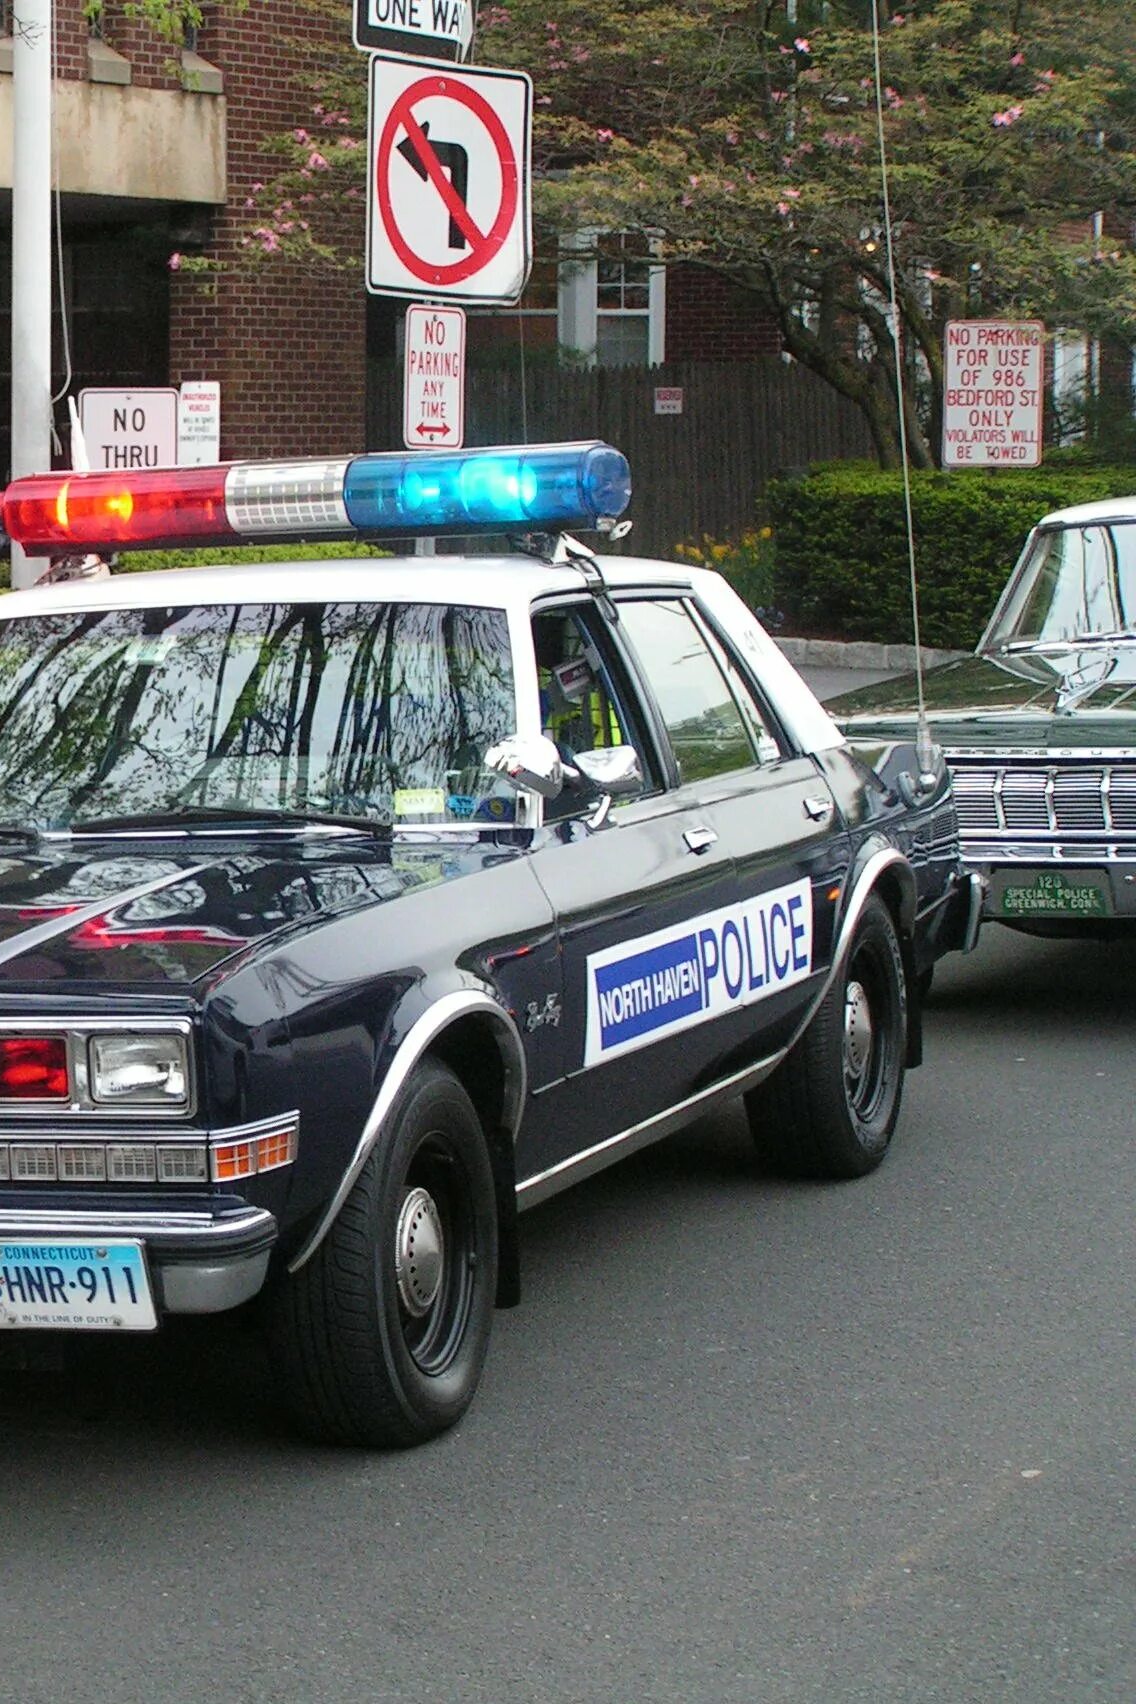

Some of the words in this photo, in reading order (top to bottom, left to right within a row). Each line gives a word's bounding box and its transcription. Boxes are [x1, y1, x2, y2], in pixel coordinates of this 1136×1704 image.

[375, 0, 421, 28] ONE
[432, 0, 463, 34] WA
[424, 320, 446, 346] NO
[949, 328, 970, 346] NO
[977, 328, 1040, 346] PARKING
[411, 351, 459, 377] PARKING
[956, 349, 988, 367] FOR
[998, 349, 1032, 367] USE
[960, 369, 982, 387] OF
[992, 369, 1026, 387] 986
[423, 379, 444, 397] ANY
[947, 389, 1015, 406] BEDFORD
[1019, 390, 1038, 407] ST.
[421, 401, 446, 419] TIME
[969, 409, 1014, 427] ONLY
[114, 408, 146, 432] NO
[946, 428, 1006, 443] VIOLATORS
[1011, 429, 1037, 444] WILL
[102, 445, 158, 469] THRU
[957, 445, 972, 459] BE
[986, 446, 1027, 460] TOWED
[1006, 888, 1050, 899] SPECIAL
[1057, 888, 1096, 899] POLICE
[699, 895, 808, 1009] POLICE
[600, 976, 652, 1028] NORTH
[653, 958, 700, 1008] HAVEN
[4, 1247, 96, 1261] CONNECTICUT
[34, 1315, 49, 1323] THE
[52, 1315, 71, 1323] LINE
[87, 1316, 110, 1324] DUTY
